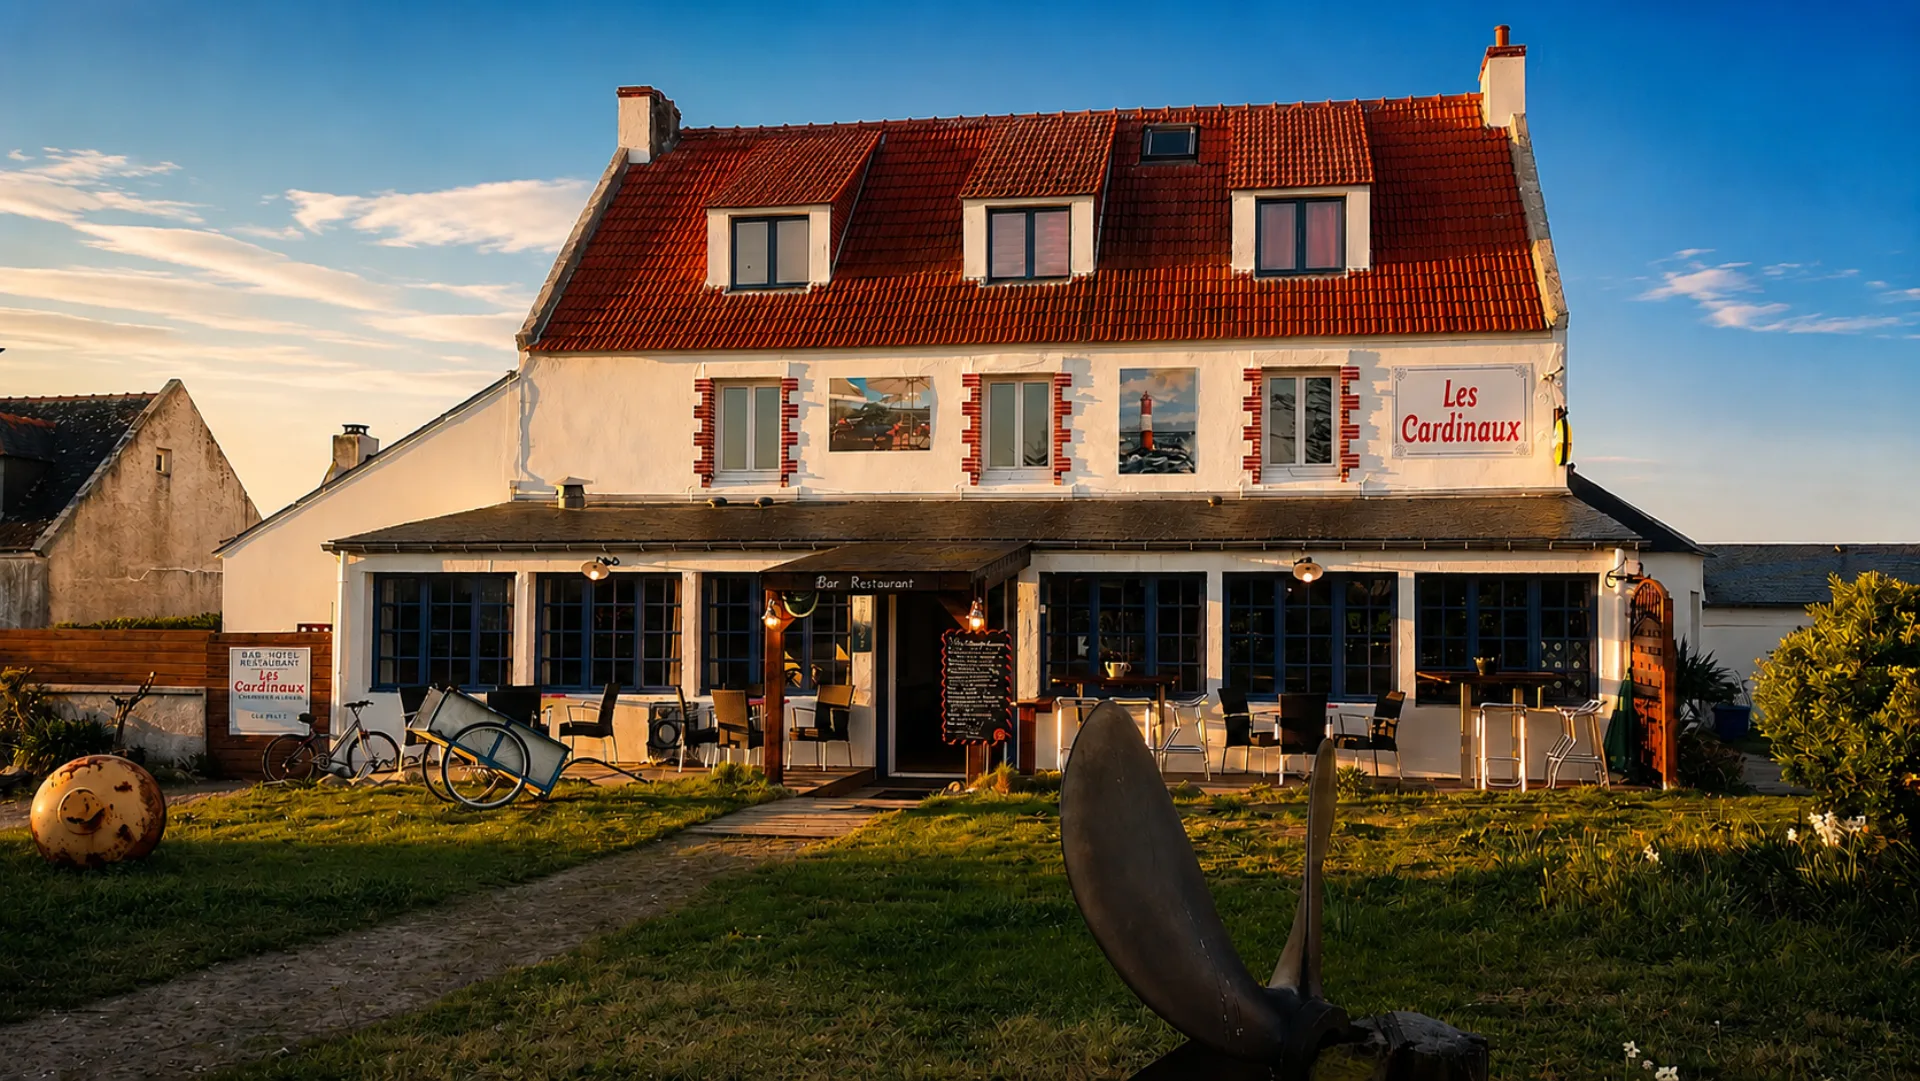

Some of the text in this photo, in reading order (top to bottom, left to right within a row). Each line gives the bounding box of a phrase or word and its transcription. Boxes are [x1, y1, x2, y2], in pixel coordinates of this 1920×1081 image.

[1443, 379, 1478, 408] Les
[1401, 411, 1521, 443] Cardinaux
[815, 575, 914, 589] Bar Restaurant
[259, 670, 279, 681] Les
[234, 680, 304, 693] Cardinaux
